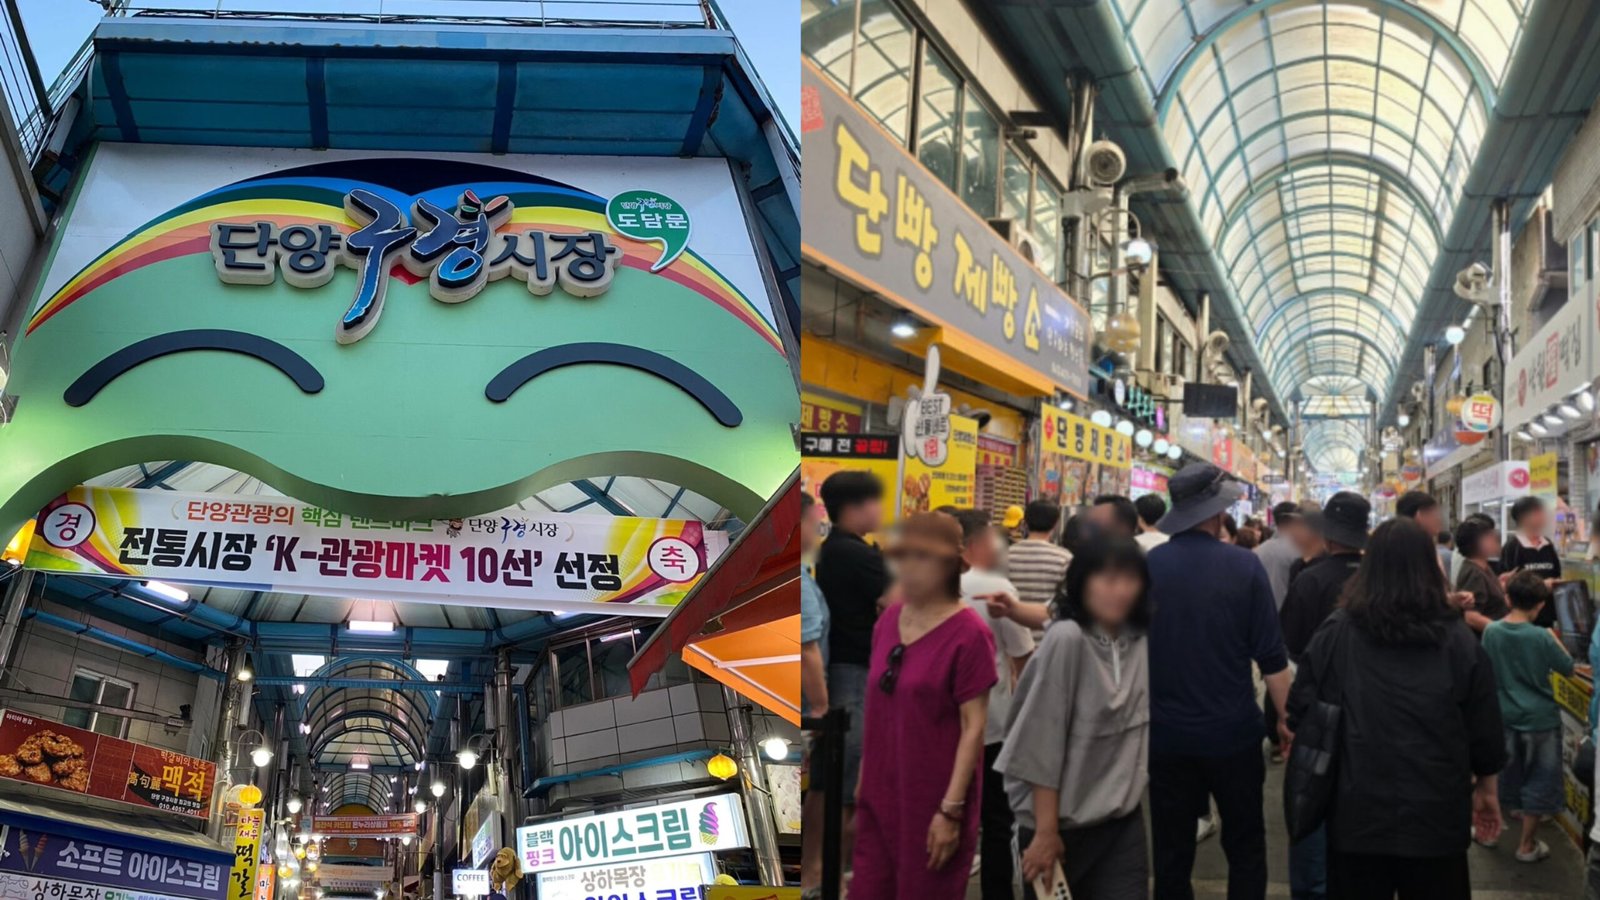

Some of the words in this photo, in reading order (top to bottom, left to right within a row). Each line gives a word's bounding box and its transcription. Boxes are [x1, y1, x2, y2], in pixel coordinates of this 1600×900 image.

[618, 213, 687, 229] 도담문
[836, 123, 938, 288] 단빵
[954, 233, 1041, 351] 제빵소
[216, 188, 616, 330] 단양구경시장
[804, 437, 833, 453] 구매
[836, 438, 851, 453] 전
[55, 513, 82, 541] 경
[187, 501, 295, 526] 단양관광의
[301, 506, 342, 529] 핵심
[468, 517, 559, 544] 단양구경시장
[119, 527, 257, 572] 전통시장
[554, 552, 622, 591] 선정
[660, 545, 686, 574] 축
[161, 751, 191, 766] 떡갈비의
[162, 765, 206, 802] 맥적
[239, 830, 258, 840] 새우
[241, 816, 260, 828] 마늘
[559, 807, 692, 862] 아이스크림
[526, 829, 554, 848] 블랙
[56, 840, 123, 875] 소프트
[128, 852, 221, 892] 아이스크림
[526, 848, 556, 866] 핑크
[457, 874, 485, 882] COFFEE
[580, 864, 646, 894] 상하목장
